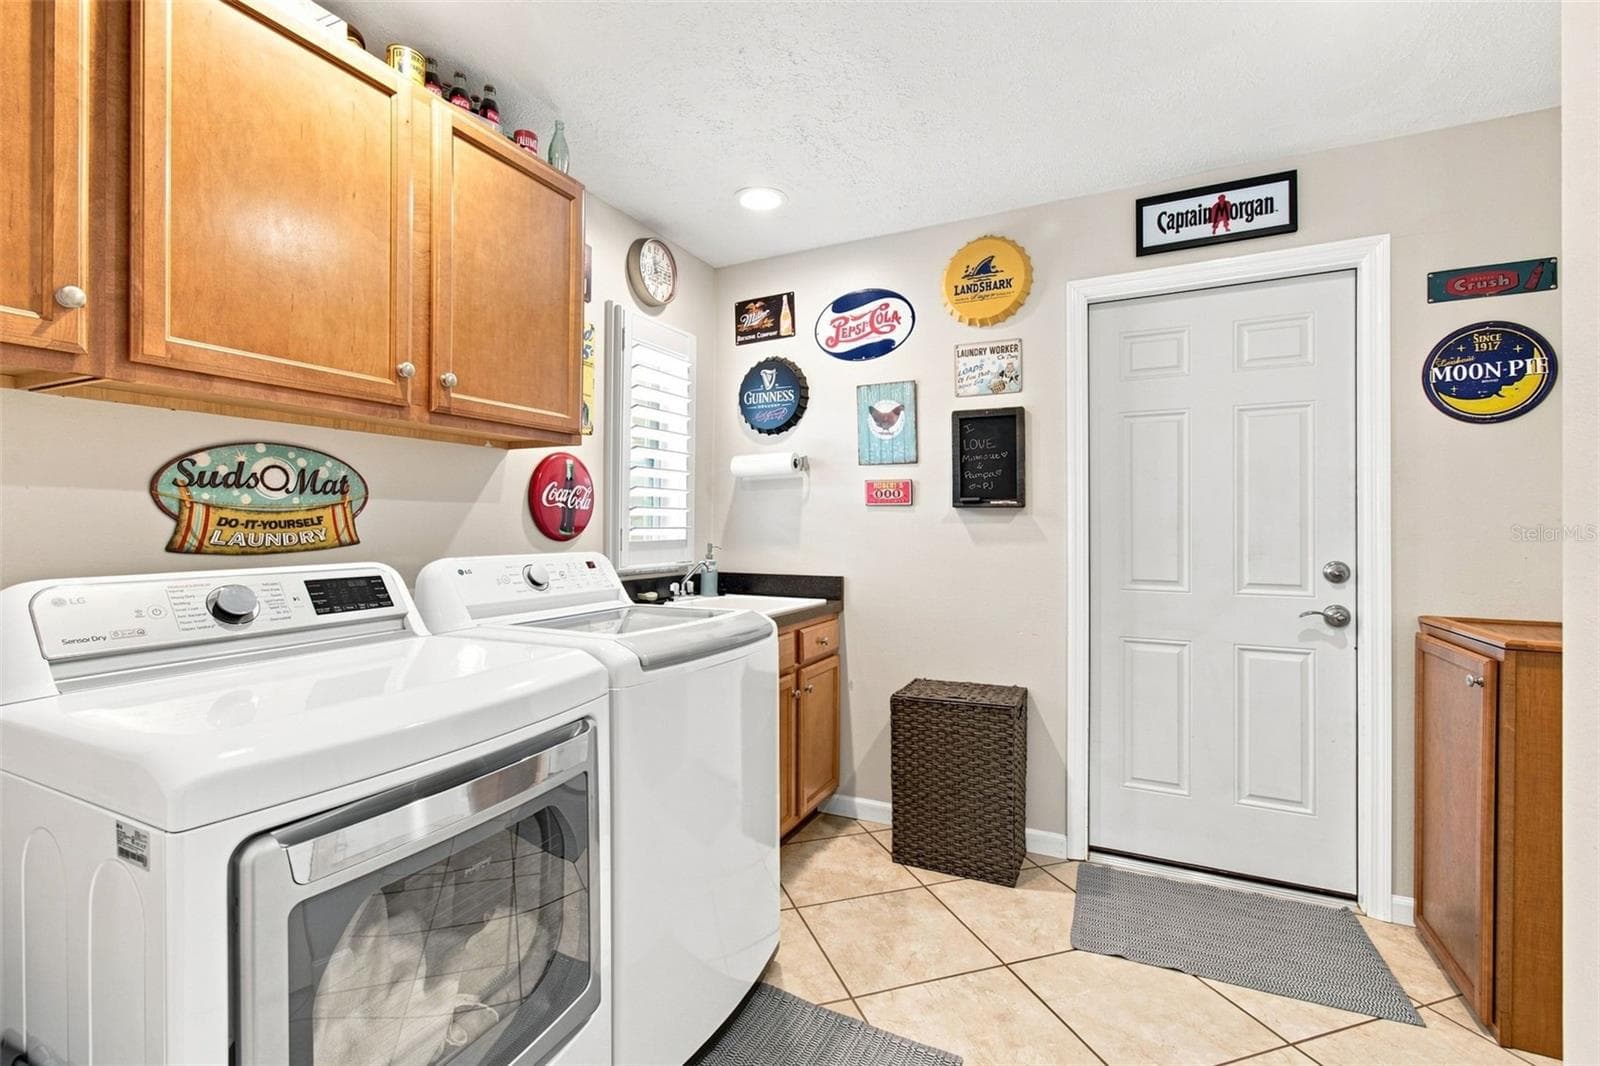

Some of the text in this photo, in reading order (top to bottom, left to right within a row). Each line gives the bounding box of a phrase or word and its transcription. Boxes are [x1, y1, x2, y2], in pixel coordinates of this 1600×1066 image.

[1157, 196, 1275, 234] Captain Morgan
[953, 278, 1013, 296] LANDSHARK
[1454, 274, 1509, 291] Crush
[1473, 333, 1502, 343] SINCE
[957, 343, 1019, 358] LAUNDRY WORKER
[1474, 342, 1501, 352] 1917
[744, 389, 795, 405] GUINNESS
[963, 423, 975, 434] I
[963, 439, 996, 451] LOVE
[172, 458, 260, 489] Suds
[285, 468, 350, 496] Mat
[209, 528, 328, 548] LAUNDRY
[69, 597, 86, 606] LG
